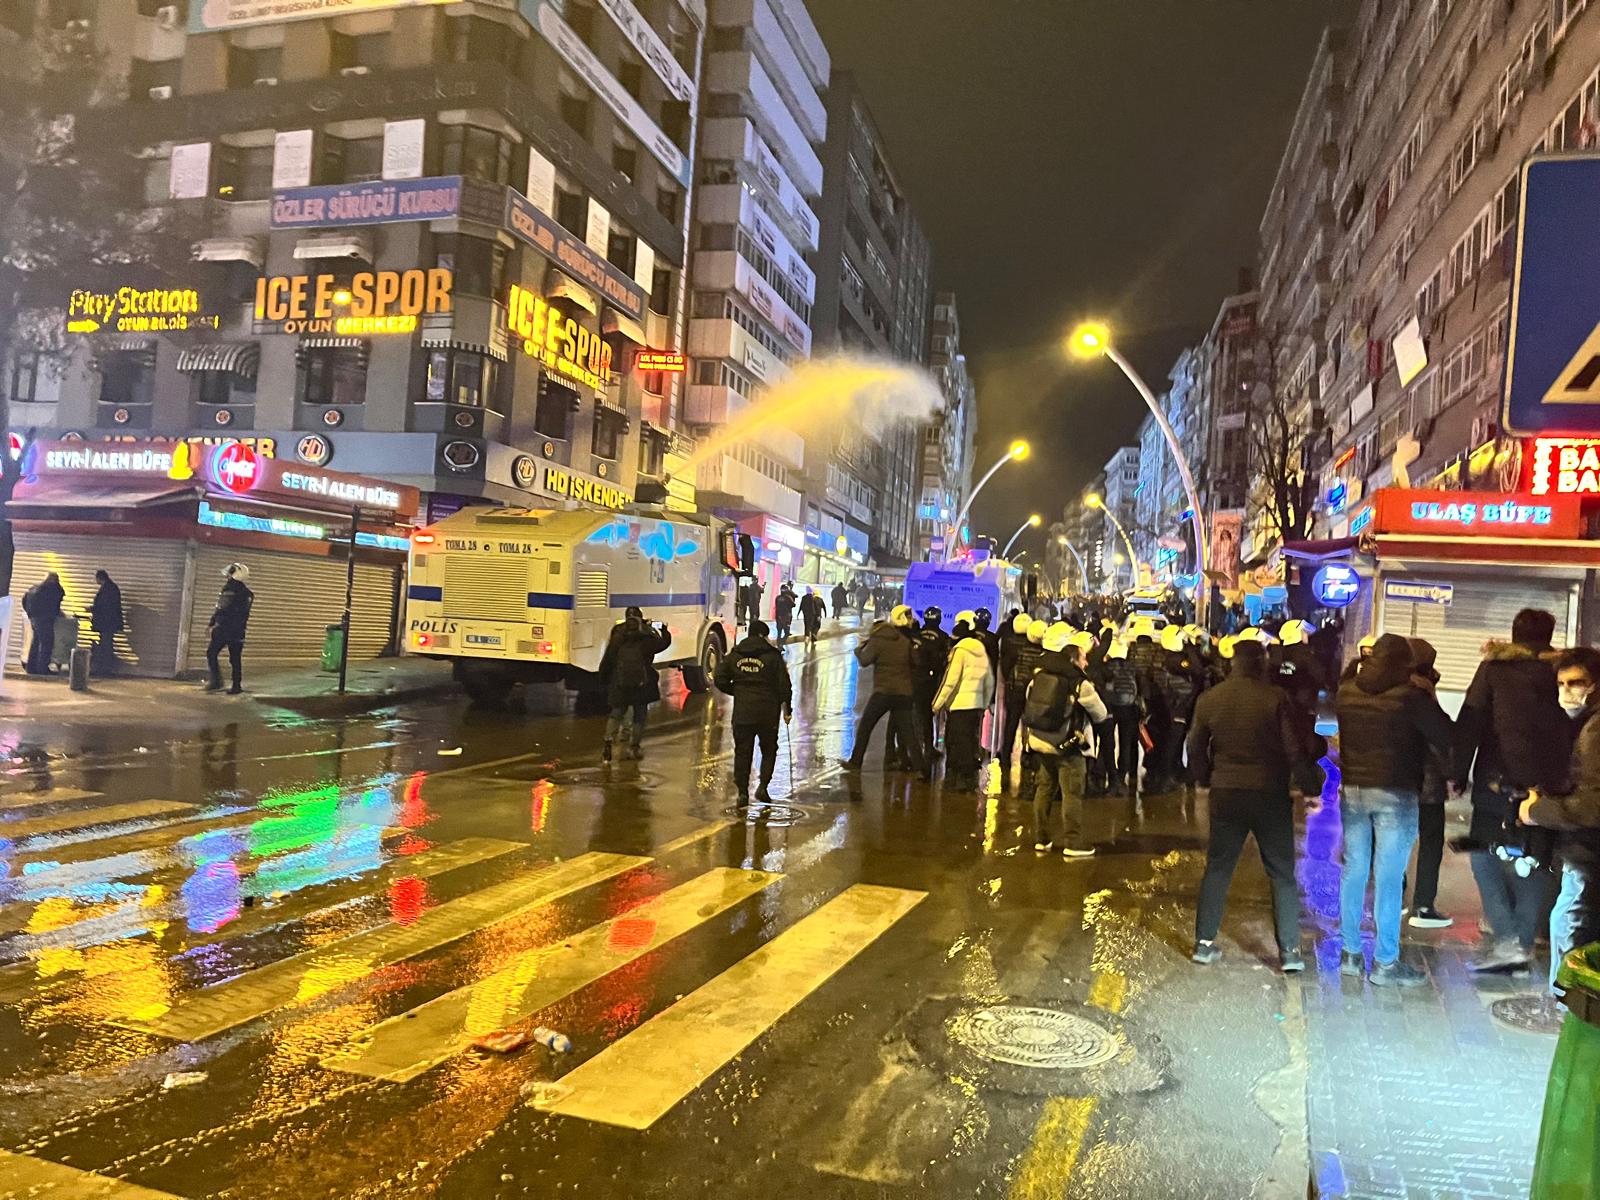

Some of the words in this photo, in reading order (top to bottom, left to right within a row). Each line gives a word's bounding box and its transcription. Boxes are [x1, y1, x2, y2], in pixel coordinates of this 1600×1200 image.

[273, 194, 325, 223] ÖZLER
[328, 188, 395, 220] SÜRÜCÜ
[398, 188, 458, 215] KURSU
[255, 276, 309, 320] ICE
[117, 317, 149, 331] OYUN
[508, 284, 549, 343] ICE
[284, 319, 333, 334] OYUN
[523, 340, 557, 368] OYUN
[133, 450, 171, 470] BÜFE
[300, 439, 322, 460] HD
[547, 468, 568, 494] HD
[1557, 470, 1600, 493] BA
[1411, 502, 1476, 525] ULAŞ
[1482, 501, 1552, 524] BÜFE
[446, 540, 466, 551] TOMA
[468, 541, 477, 551] 28
[499, 543, 519, 553] TOMA
[522, 543, 531, 553] 28
[410, 619, 458, 634] POLİS
